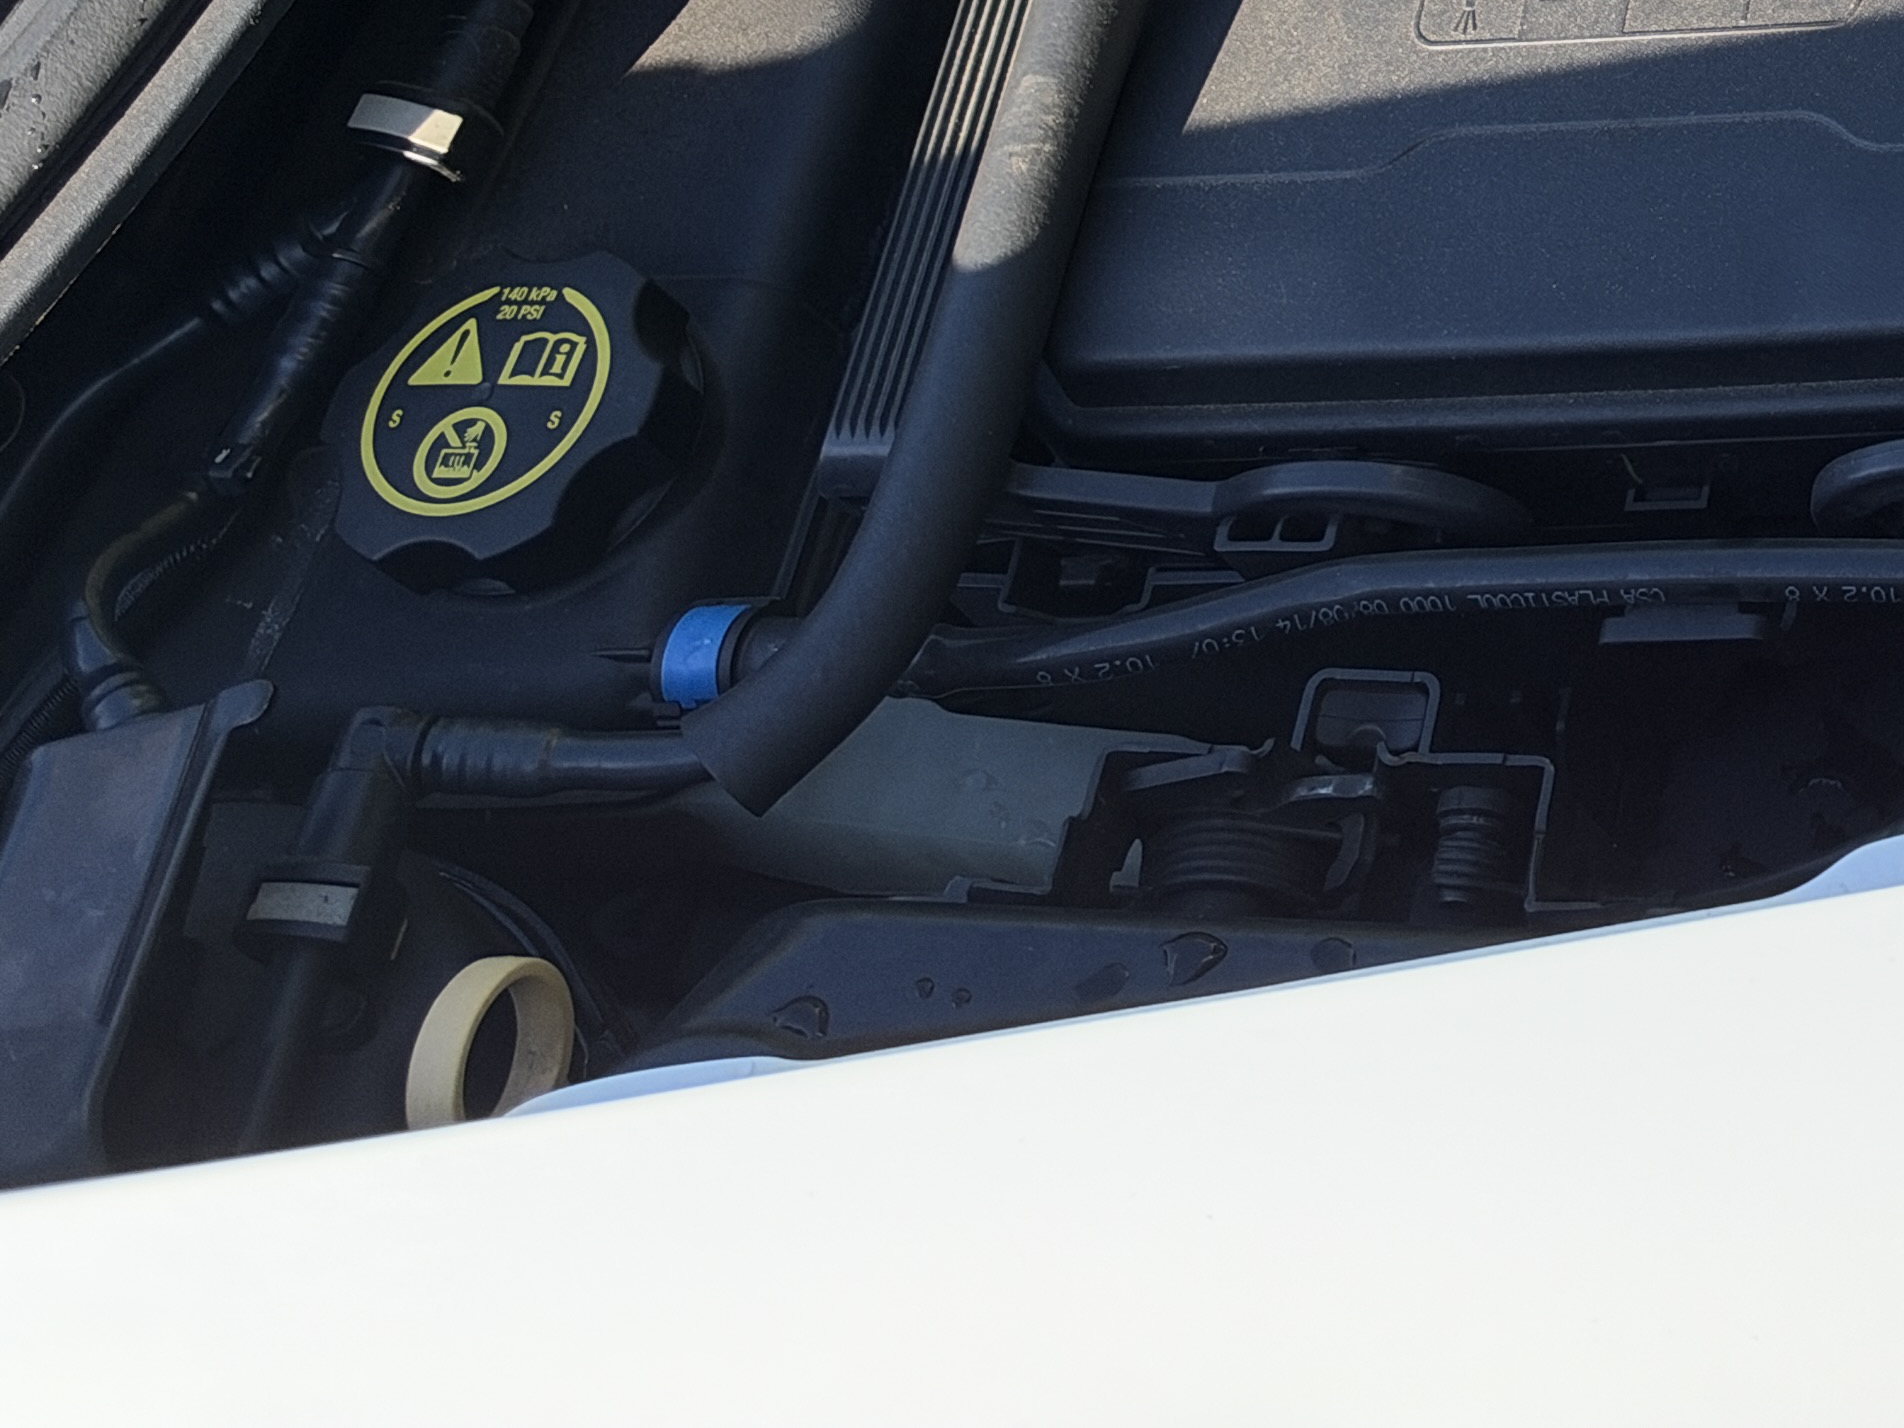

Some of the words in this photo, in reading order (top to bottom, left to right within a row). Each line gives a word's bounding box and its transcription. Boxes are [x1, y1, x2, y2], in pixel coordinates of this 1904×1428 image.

[501, 286, 528, 303] 140
[528, 286, 557, 303] kPa
[496, 304, 518, 320] 20
[519, 304, 545, 320] PSI
